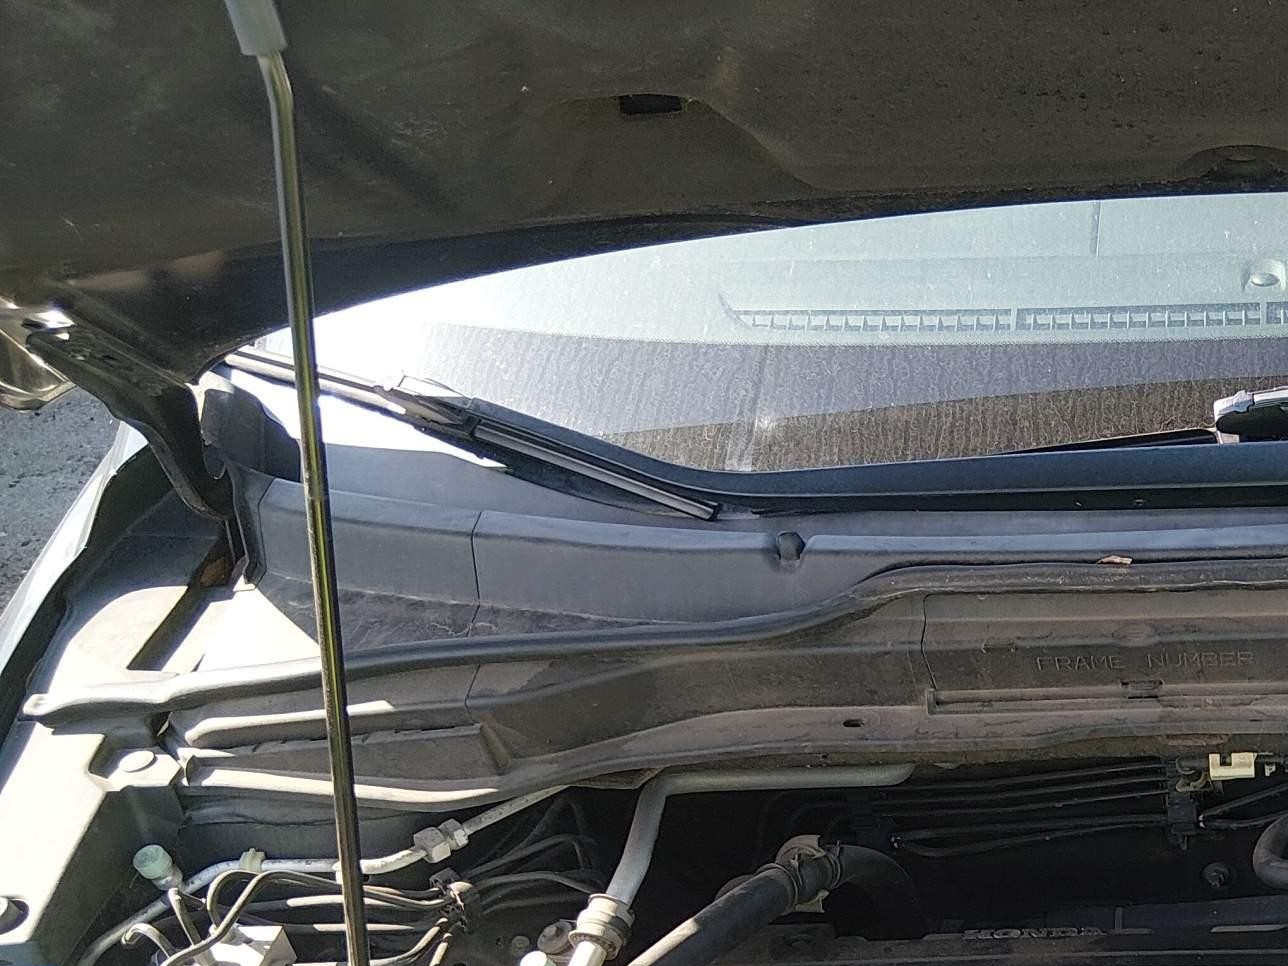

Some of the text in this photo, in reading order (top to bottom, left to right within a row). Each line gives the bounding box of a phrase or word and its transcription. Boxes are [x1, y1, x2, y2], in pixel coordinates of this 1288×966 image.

[1035, 650, 1254, 671] FRAME NUMBER
[963, 927, 1107, 940] HONDA
